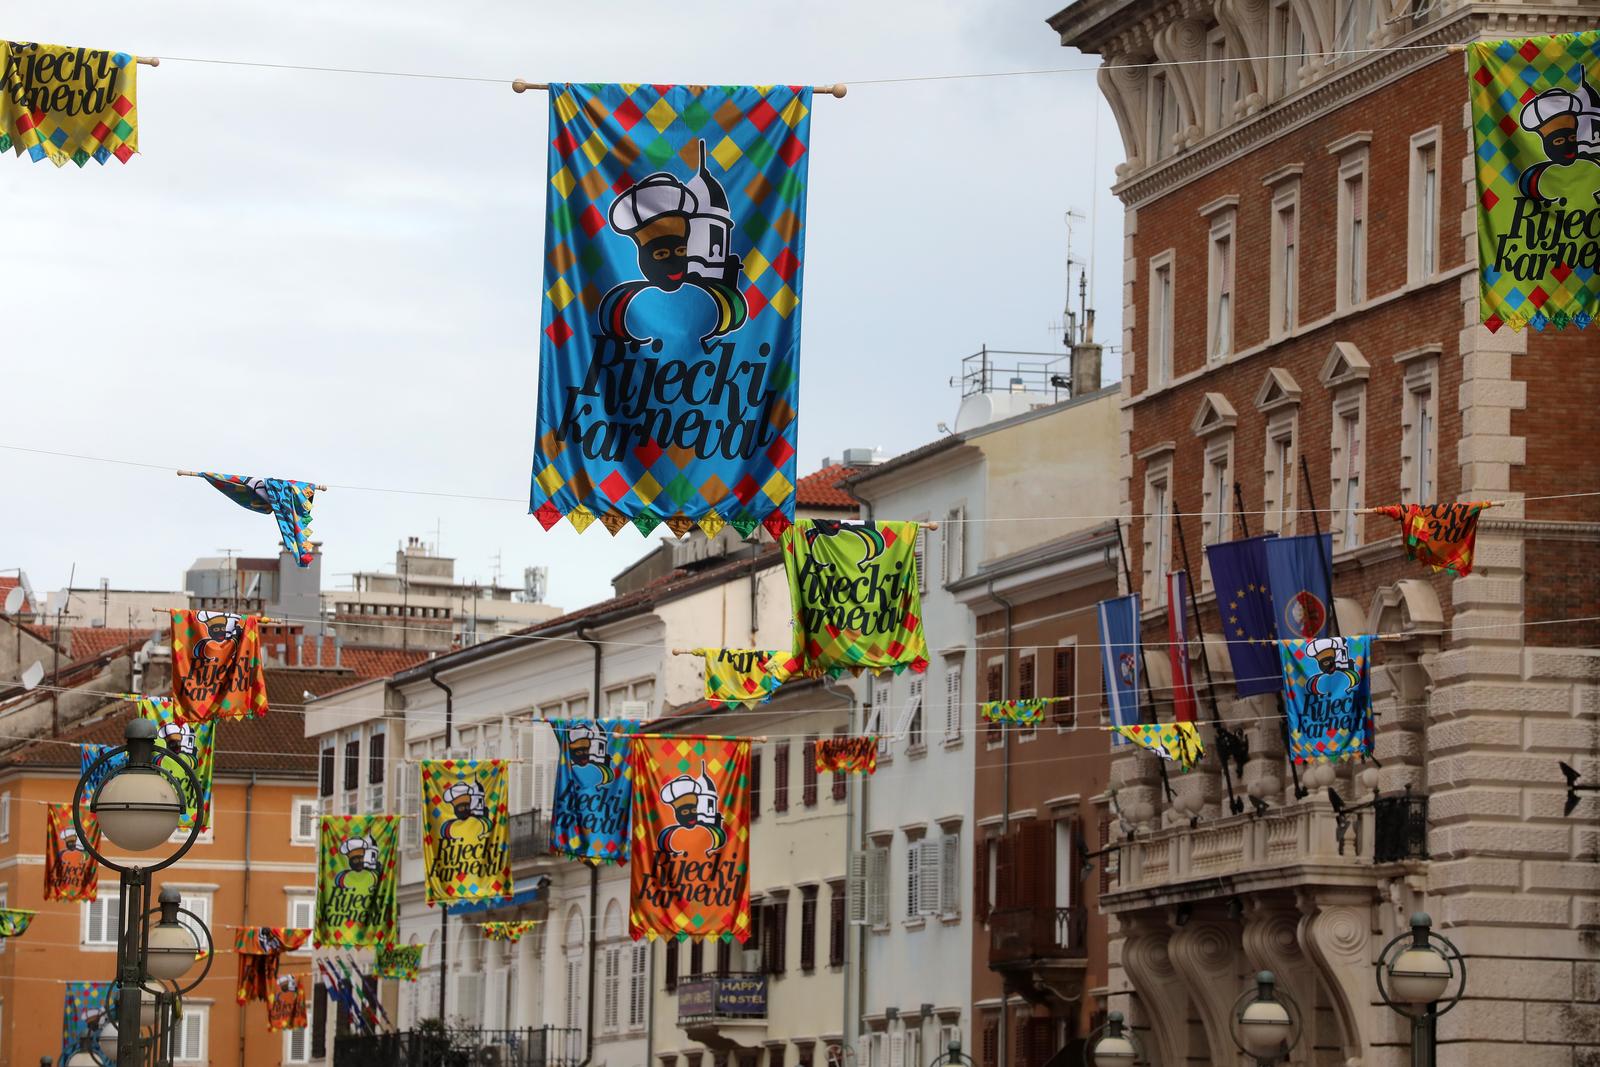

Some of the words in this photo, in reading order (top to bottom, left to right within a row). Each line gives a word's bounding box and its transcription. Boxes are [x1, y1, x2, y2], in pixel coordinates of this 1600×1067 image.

[556, 386, 777, 462] karneval
[639, 872, 743, 909] karneval
[721, 981, 764, 993] HAPPY
[719, 995, 766, 1004] HOSTEL
